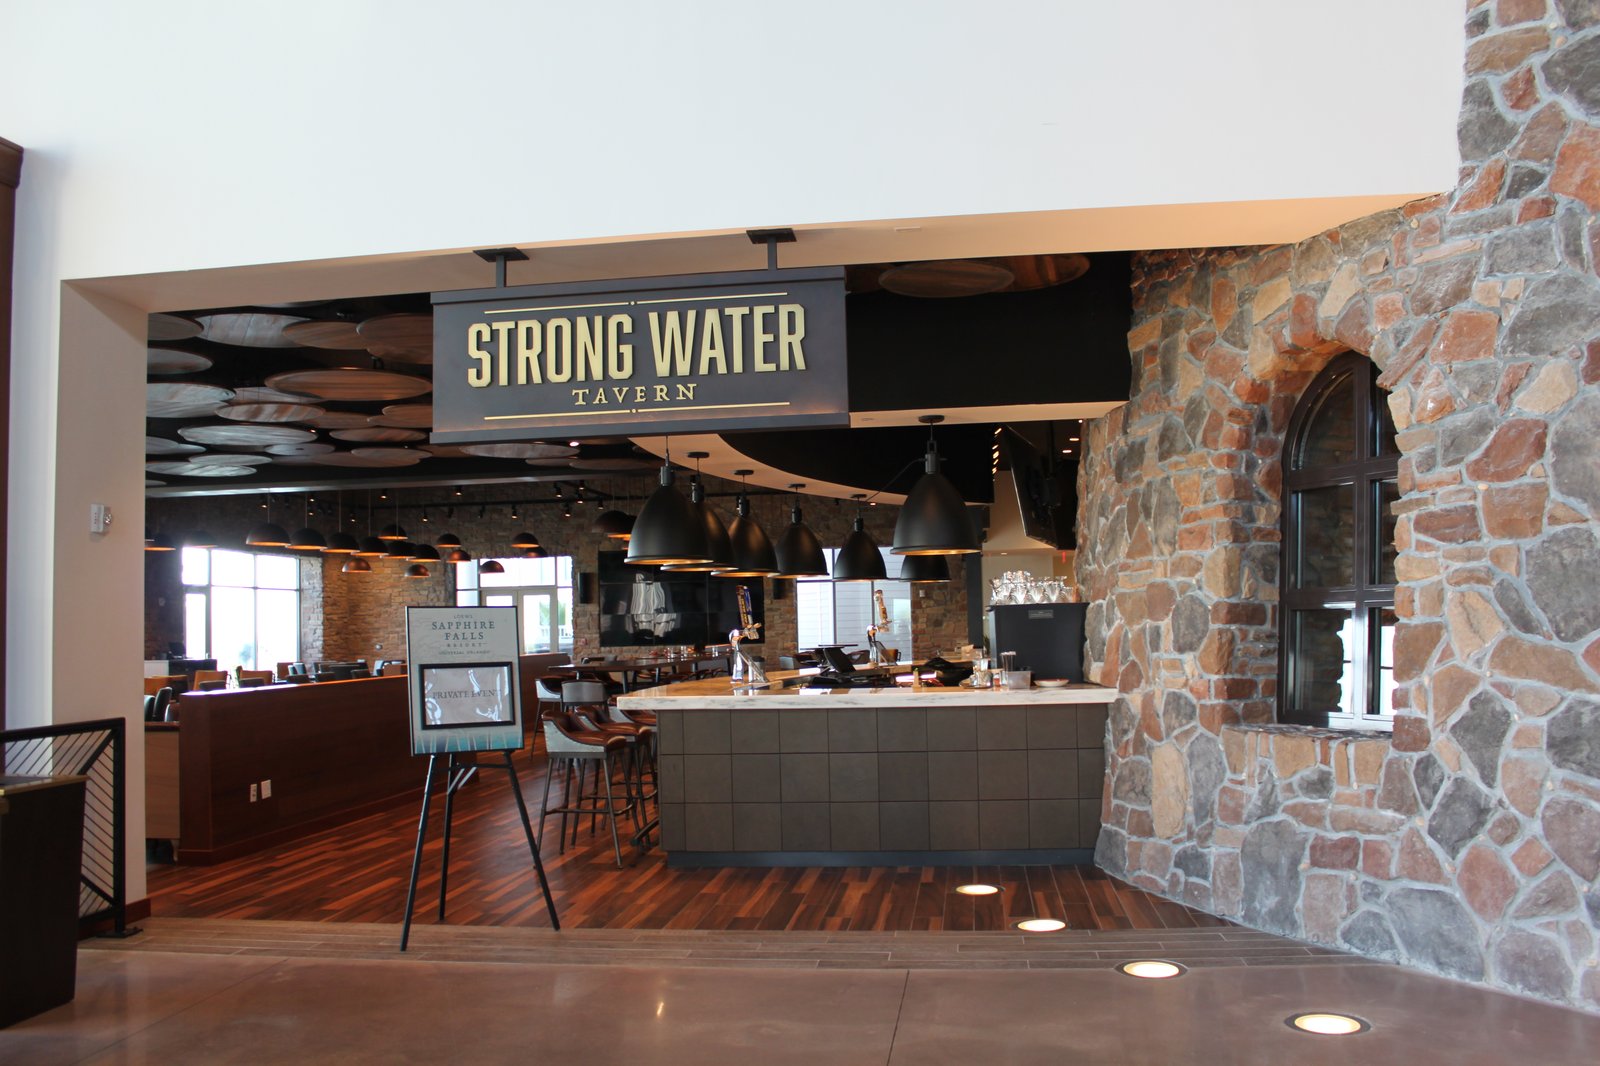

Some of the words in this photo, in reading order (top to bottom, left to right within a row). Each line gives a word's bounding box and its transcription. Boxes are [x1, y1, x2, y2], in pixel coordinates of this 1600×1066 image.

[468, 314, 634, 388] STRONG
[649, 303, 807, 377] WATER
[572, 383, 698, 405] TAVERN
[432, 621, 495, 630] SAPPHIRE
[445, 632, 484, 640] FALLS
[432, 690, 468, 699] PRIVATE
